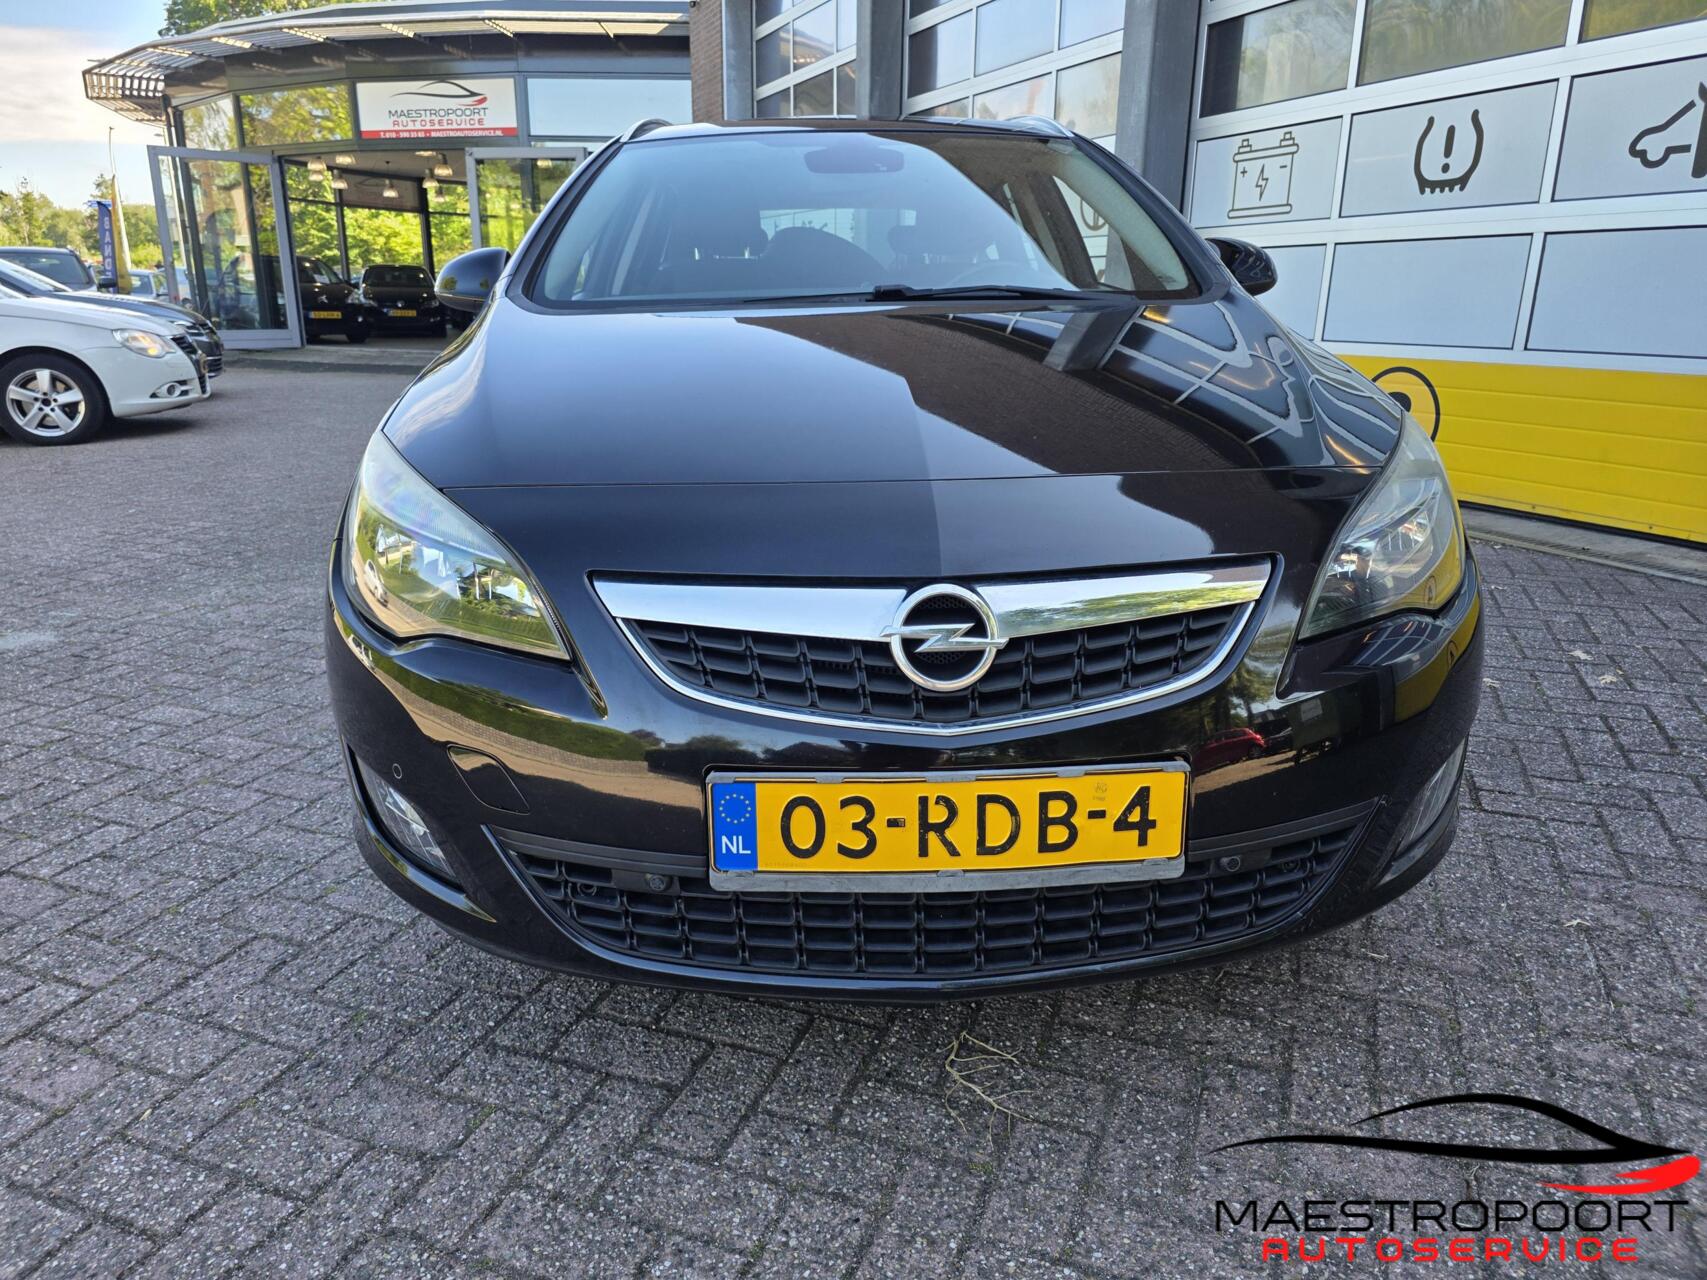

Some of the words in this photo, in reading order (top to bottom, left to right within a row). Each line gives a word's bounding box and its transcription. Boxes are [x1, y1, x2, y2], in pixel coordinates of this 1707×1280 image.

[388, 107, 489, 119] MAESTROPOORT
[392, 118, 485, 128] AUTOSERVICE
[780, 785, 1157, 860] 03-RDB-4
[721, 835, 751, 855] NL
